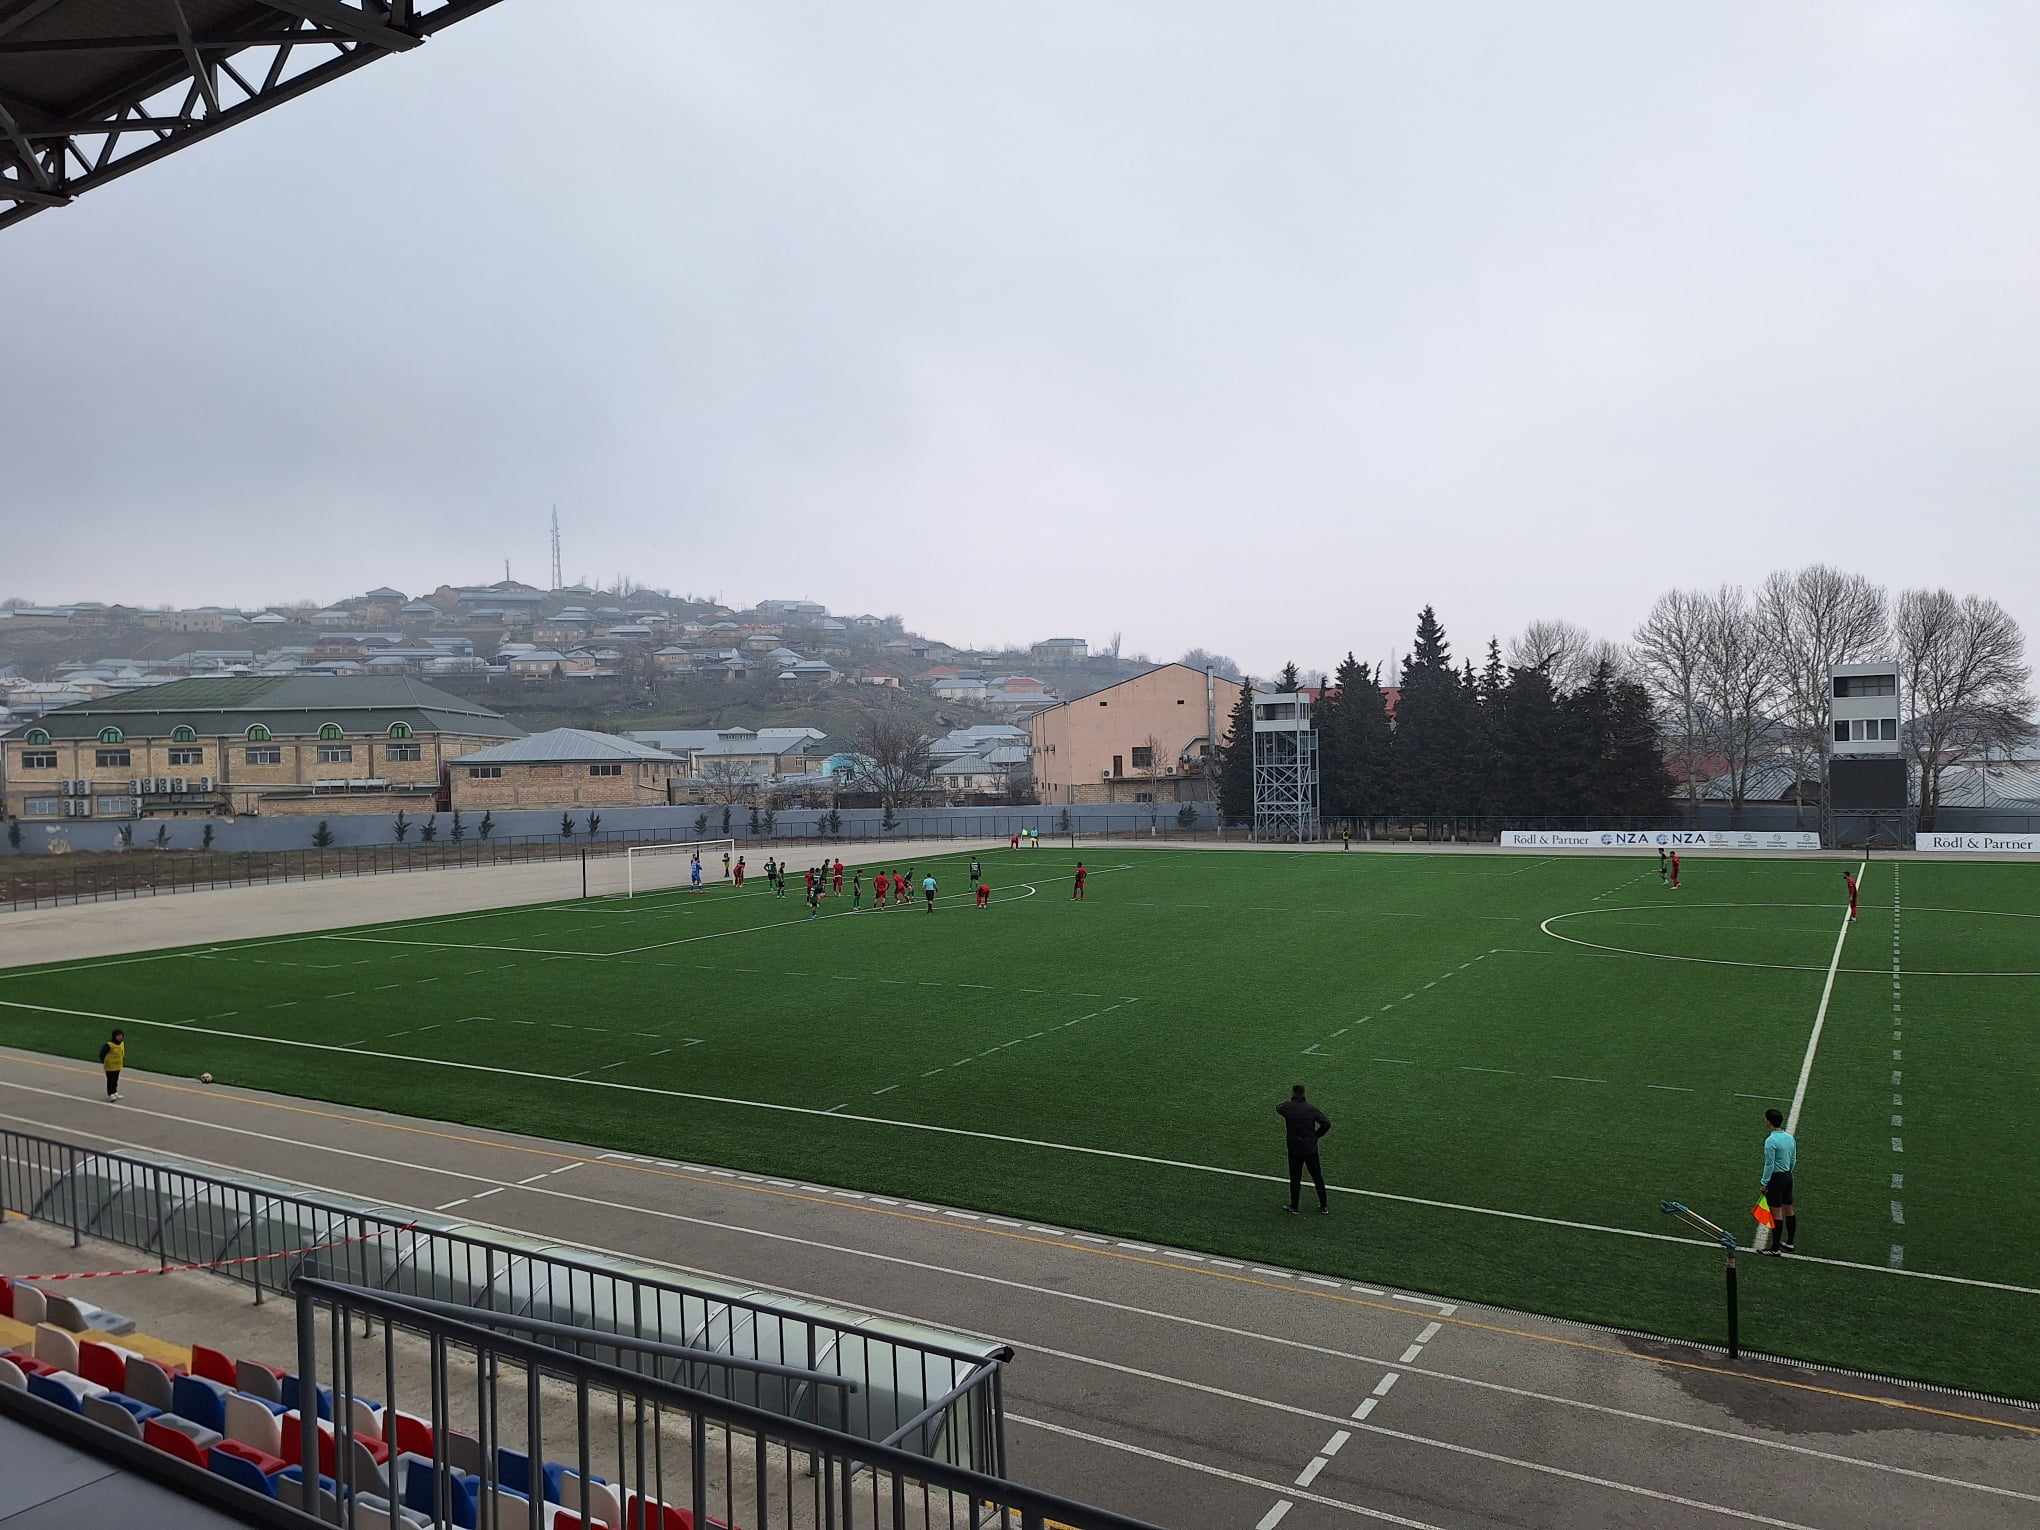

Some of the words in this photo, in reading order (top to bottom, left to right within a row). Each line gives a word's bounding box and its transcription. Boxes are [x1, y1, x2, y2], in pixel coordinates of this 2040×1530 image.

[1539, 835, 1548, 844] &
[1552, 834, 1589, 845] Partner
[1616, 833, 1648, 844] NZA
[1672, 833, 1706, 844] NZA
[1967, 837, 1980, 849] &
[1984, 837, 2033, 850] Partner
